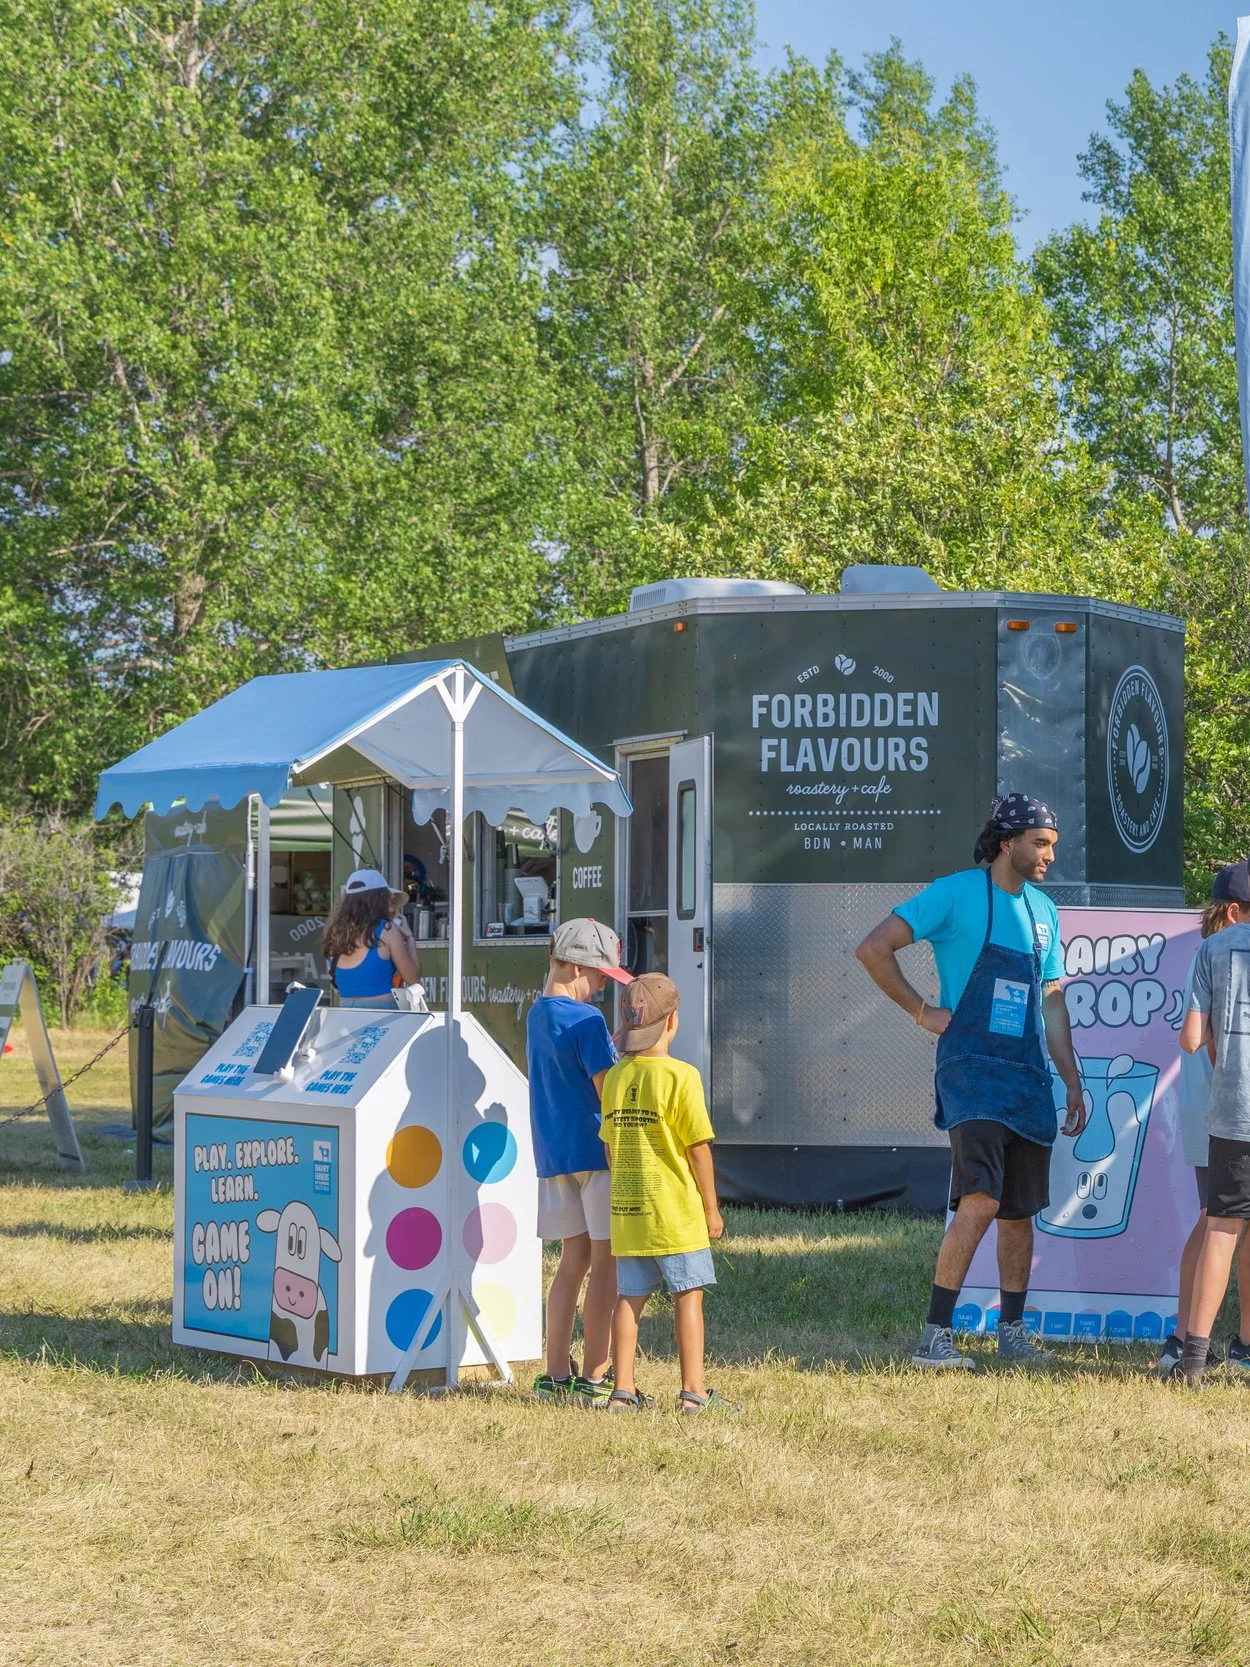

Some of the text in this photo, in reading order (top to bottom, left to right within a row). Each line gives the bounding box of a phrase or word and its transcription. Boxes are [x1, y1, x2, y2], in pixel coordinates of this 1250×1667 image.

[797, 665, 820, 683] ESTD
[873, 666, 894, 683] 2000
[752, 692, 939, 728] FORBIDDEN
[1112, 679, 1165, 756] FORBIDDEN FLAVOURS
[761, 737, 929, 772] FLAVOURS
[786, 781, 849, 805] roastery
[861, 775, 892, 803] cafe
[794, 822, 894, 831] LOCALLY ROASTED
[1116, 794, 1160, 837] ROASTERY AND CAFE
[804, 837, 882, 849] BDN MAN
[573, 865, 602, 889] COFFEE
[1061, 933, 1167, 977] AIRY
[440, 976, 486, 1002] FLOURS
[1064, 978, 1167, 1028] ROP
[200, 1075, 246, 1086] GAMES HERE
[214, 1063, 231, 1073] PLAY
[320, 1070, 358, 1082] PLAY THE
[305, 1082, 353, 1095] GAMES HERE
[194, 1136, 299, 1173] PLAY. EXPLORE.
[211, 1173, 259, 1204] LEARN.
[192, 1220, 250, 1265] GAME
[203, 1265, 242, 1311] ON!
